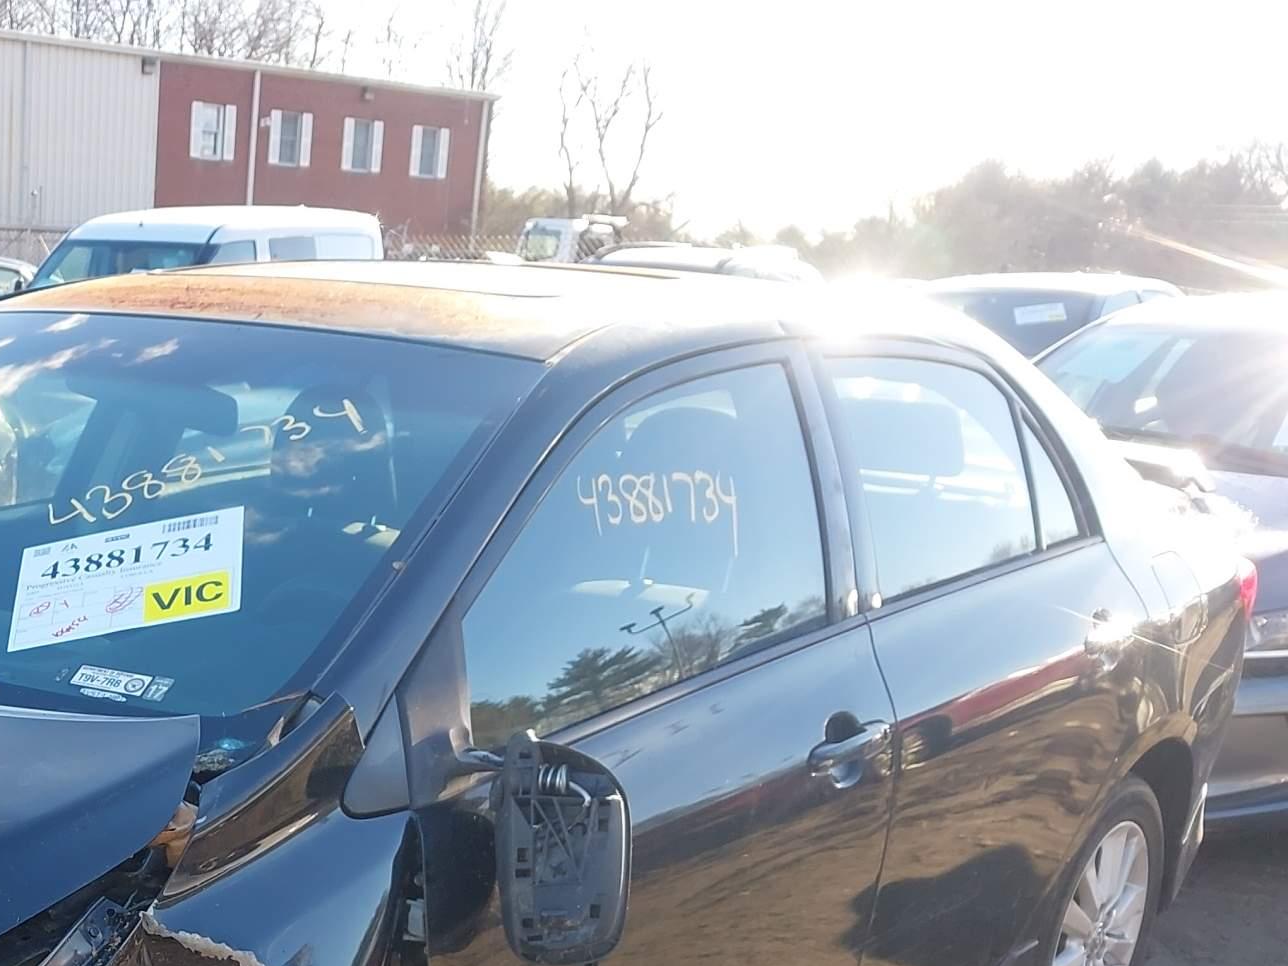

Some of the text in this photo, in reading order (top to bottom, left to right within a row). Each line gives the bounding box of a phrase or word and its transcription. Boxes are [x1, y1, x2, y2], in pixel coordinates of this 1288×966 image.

[577, 470, 739, 557] 43881734
[40, 532, 214, 579] 43881734
[152, 580, 224, 610] VIC
